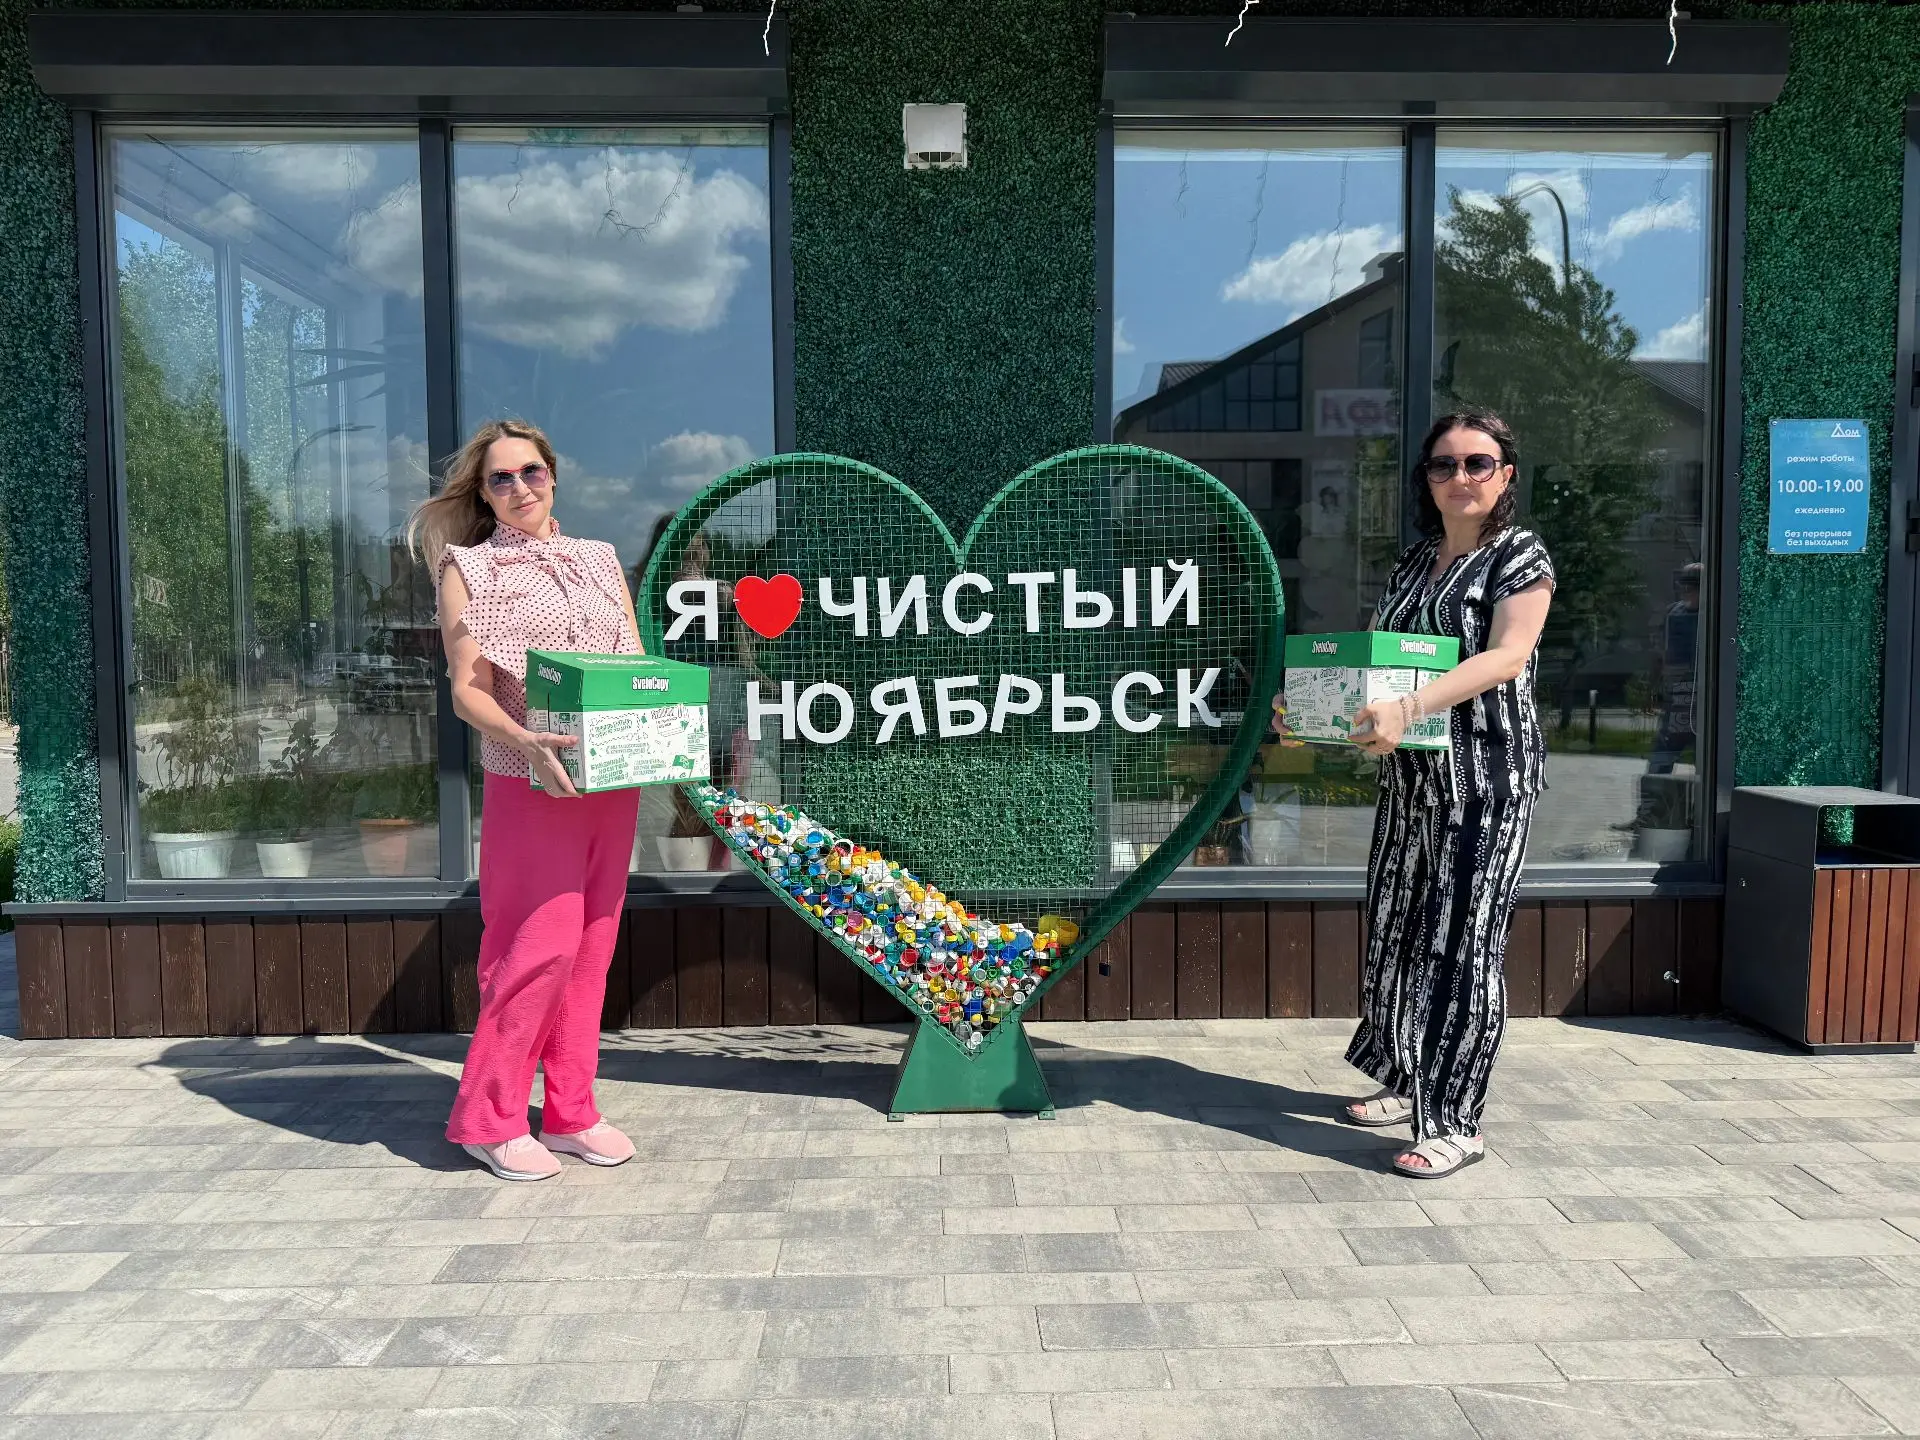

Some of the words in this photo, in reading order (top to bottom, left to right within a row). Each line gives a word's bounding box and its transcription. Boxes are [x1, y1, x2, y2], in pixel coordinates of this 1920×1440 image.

[1786, 455, 1818, 464] режим
[1820, 454, 1855, 464] работы
[1777, 479, 1864, 493] 10.00-19.00
[1794, 506, 1846, 515] ежедневно
[1784, 529, 1800, 538] без
[1802, 530, 1852, 539] перерывов
[1786, 538, 1803, 546] без
[663, 580, 719, 642] Я
[818, 559, 1201, 638] ЧИСТЫЙ
[1399, 638, 1437, 657] SvetoCopy
[537, 663, 563, 686] SvetoCopy
[632, 676, 670, 692] SvetoCopy
[746, 667, 1222, 744] НОЯБРЬСК
